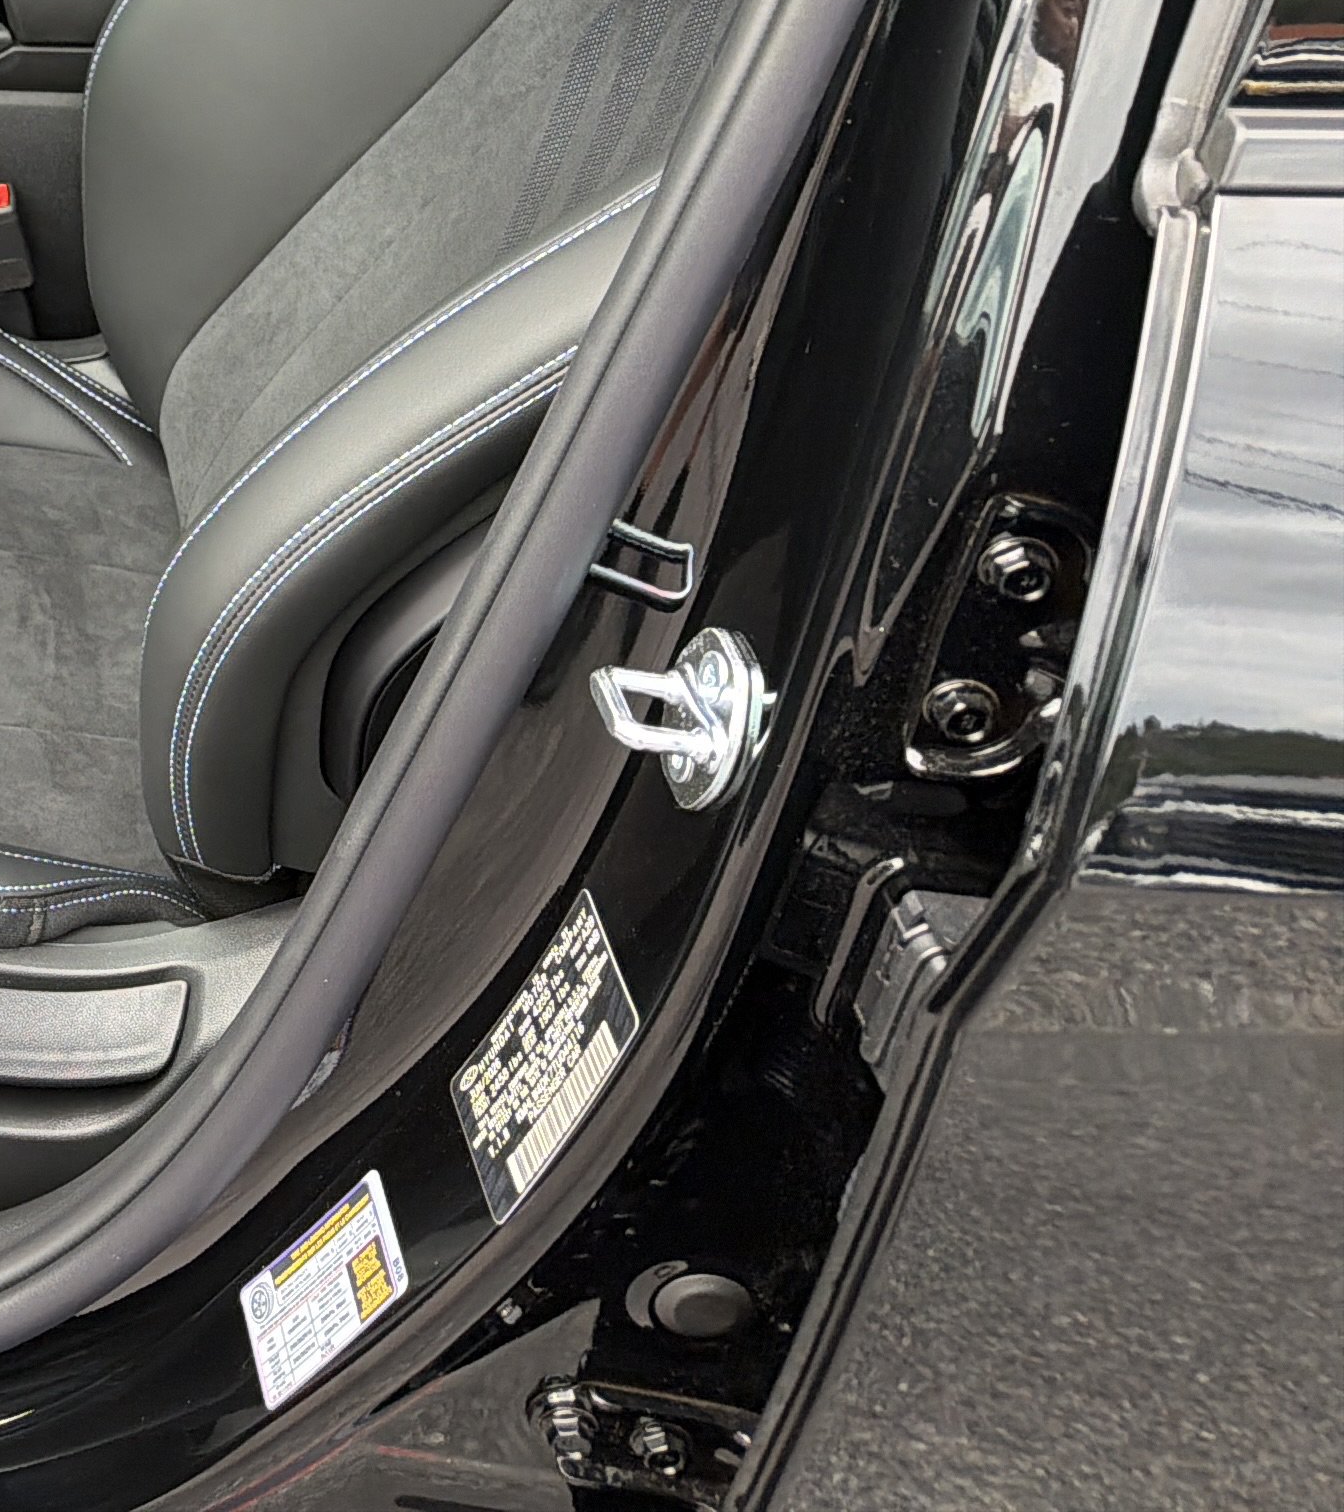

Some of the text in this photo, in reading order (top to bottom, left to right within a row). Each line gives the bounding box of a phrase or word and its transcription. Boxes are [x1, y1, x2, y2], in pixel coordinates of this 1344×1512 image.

[477, 1018, 515, 1077] HYUNDAI
[520, 971, 548, 1015] MOTOR
[552, 907, 589, 966] COMPANY
[527, 1064, 566, 1125] PASSENGER
